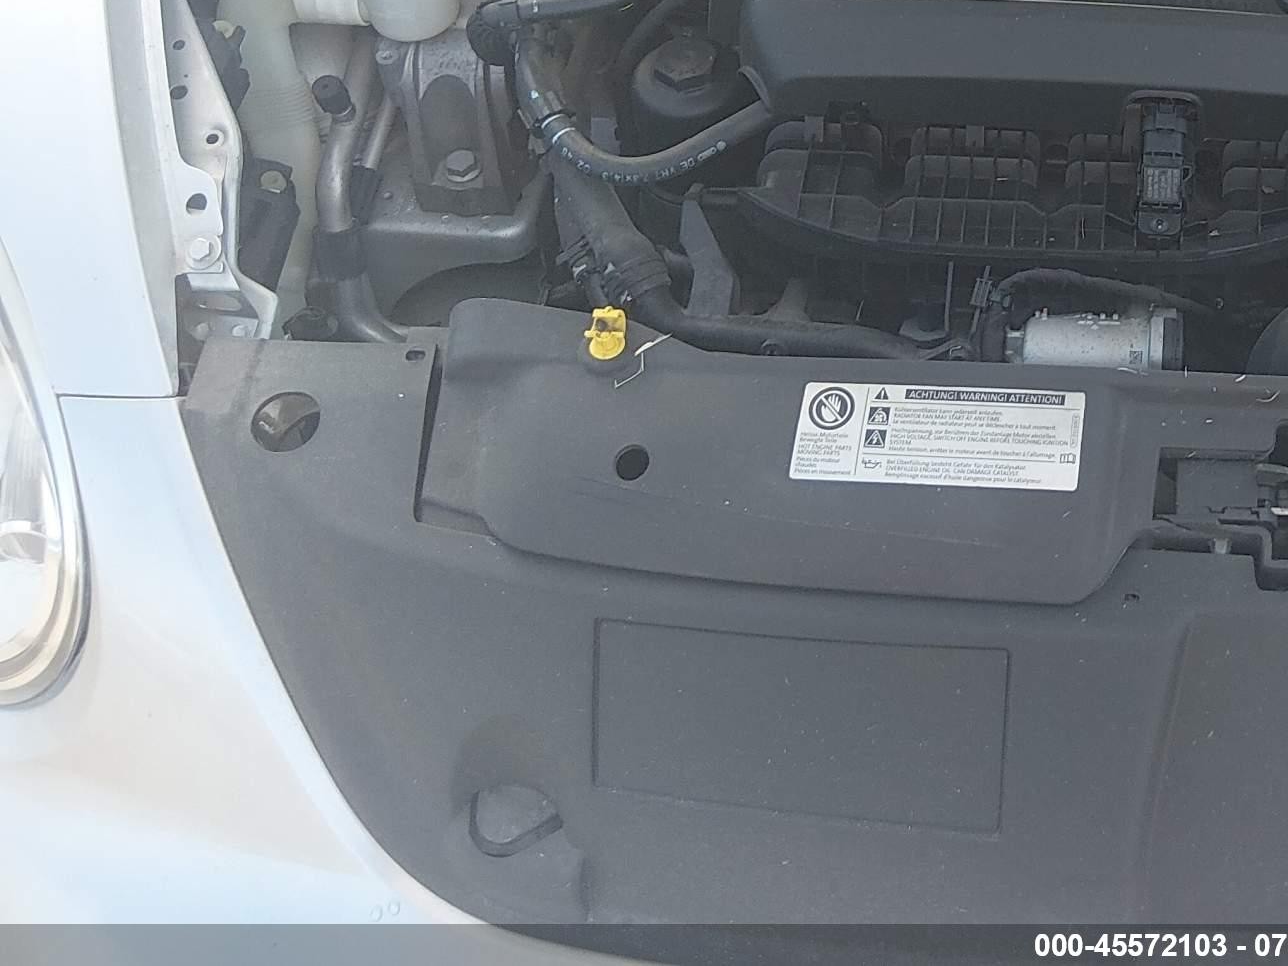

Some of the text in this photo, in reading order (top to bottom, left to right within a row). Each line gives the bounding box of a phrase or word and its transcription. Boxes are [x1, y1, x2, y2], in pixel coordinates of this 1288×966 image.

[908, 390, 1062, 404] ACHTUNG! WARNING! ATTENTION!
